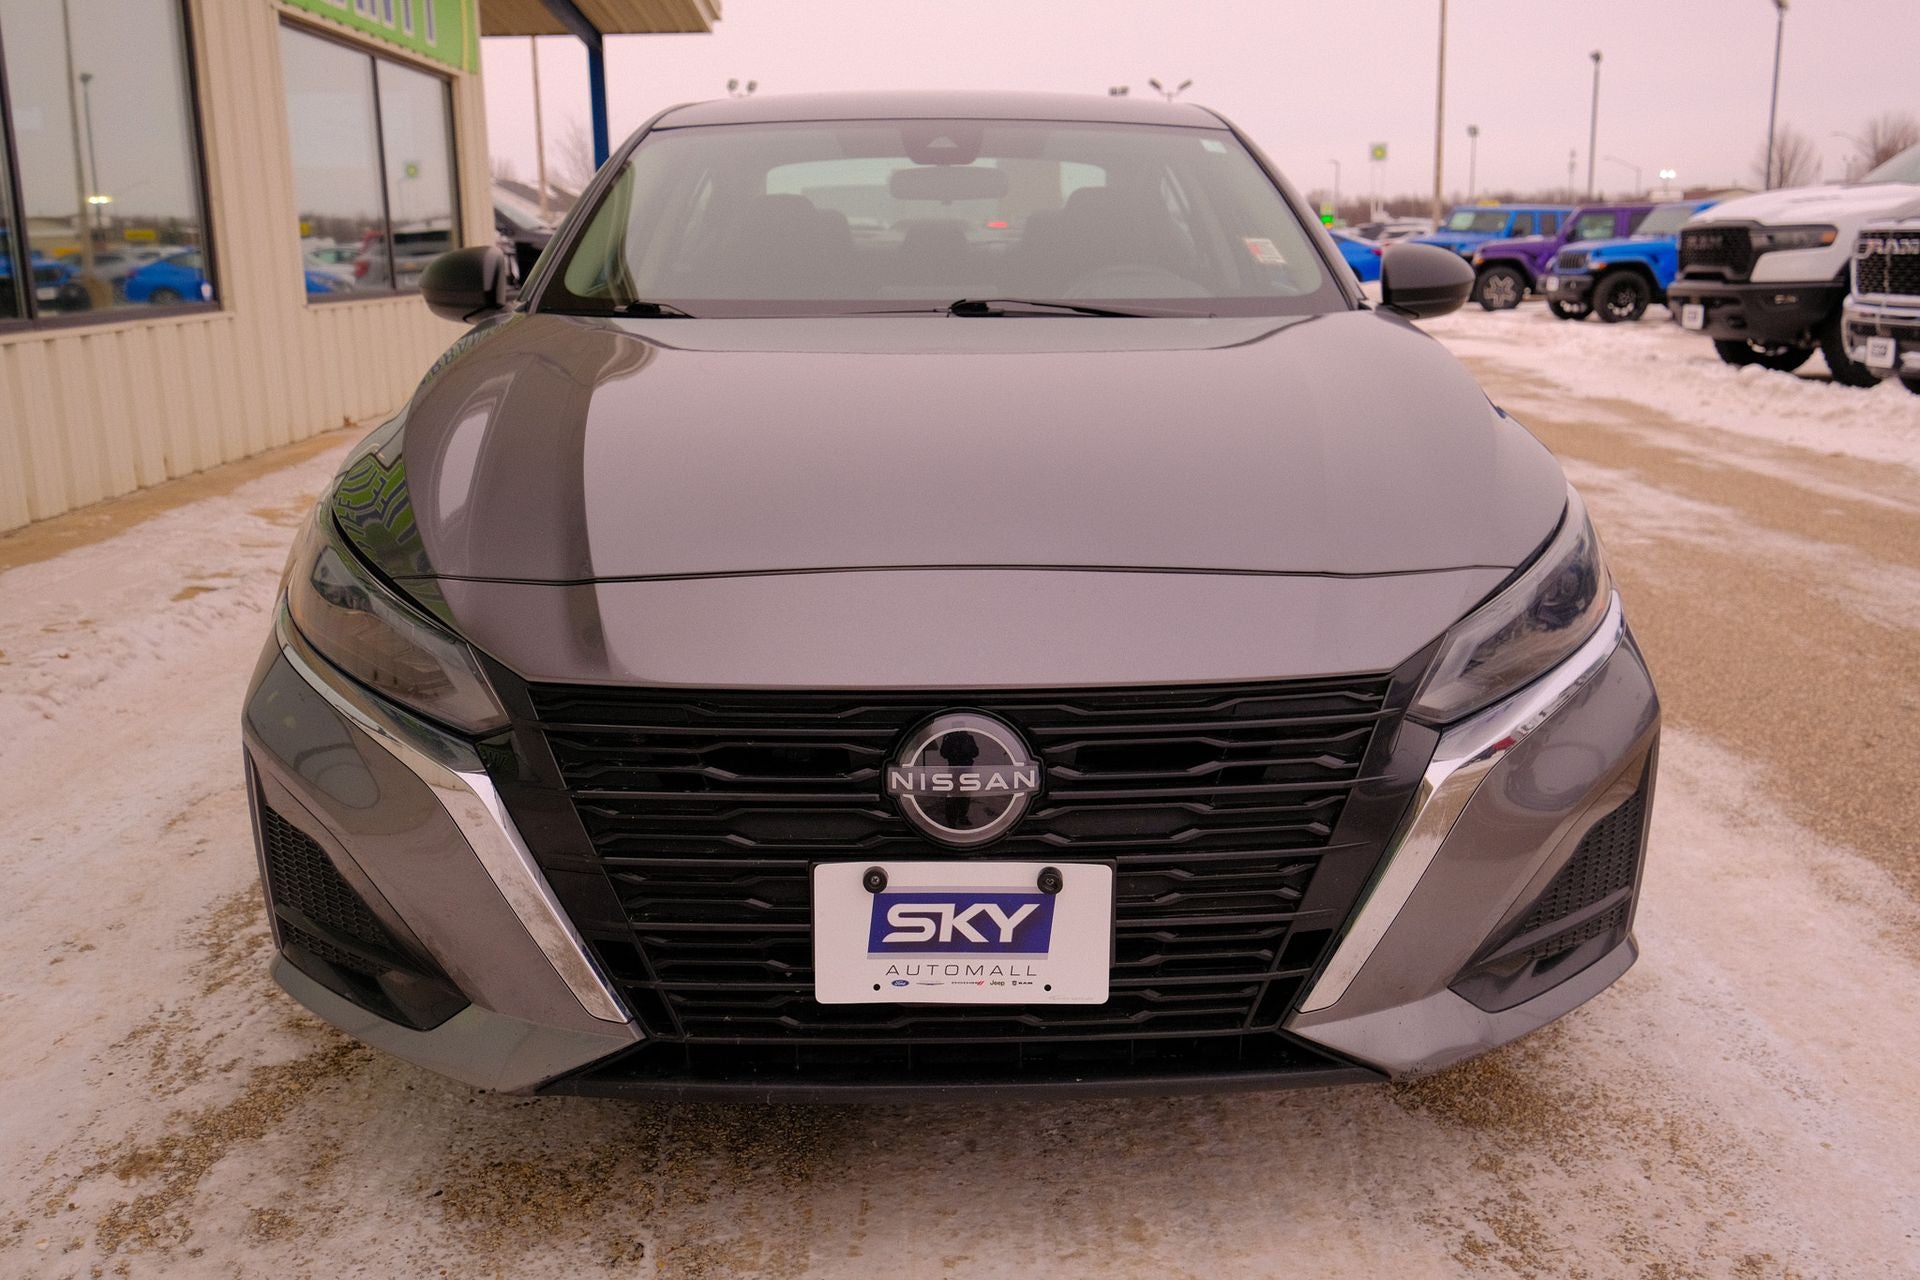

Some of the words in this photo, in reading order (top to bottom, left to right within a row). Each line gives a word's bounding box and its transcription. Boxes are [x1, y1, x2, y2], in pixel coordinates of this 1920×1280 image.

[891, 770, 1035, 791] NISSAN
[882, 903, 1040, 943] SKY
[885, 964, 1037, 976] AUTOMALL
